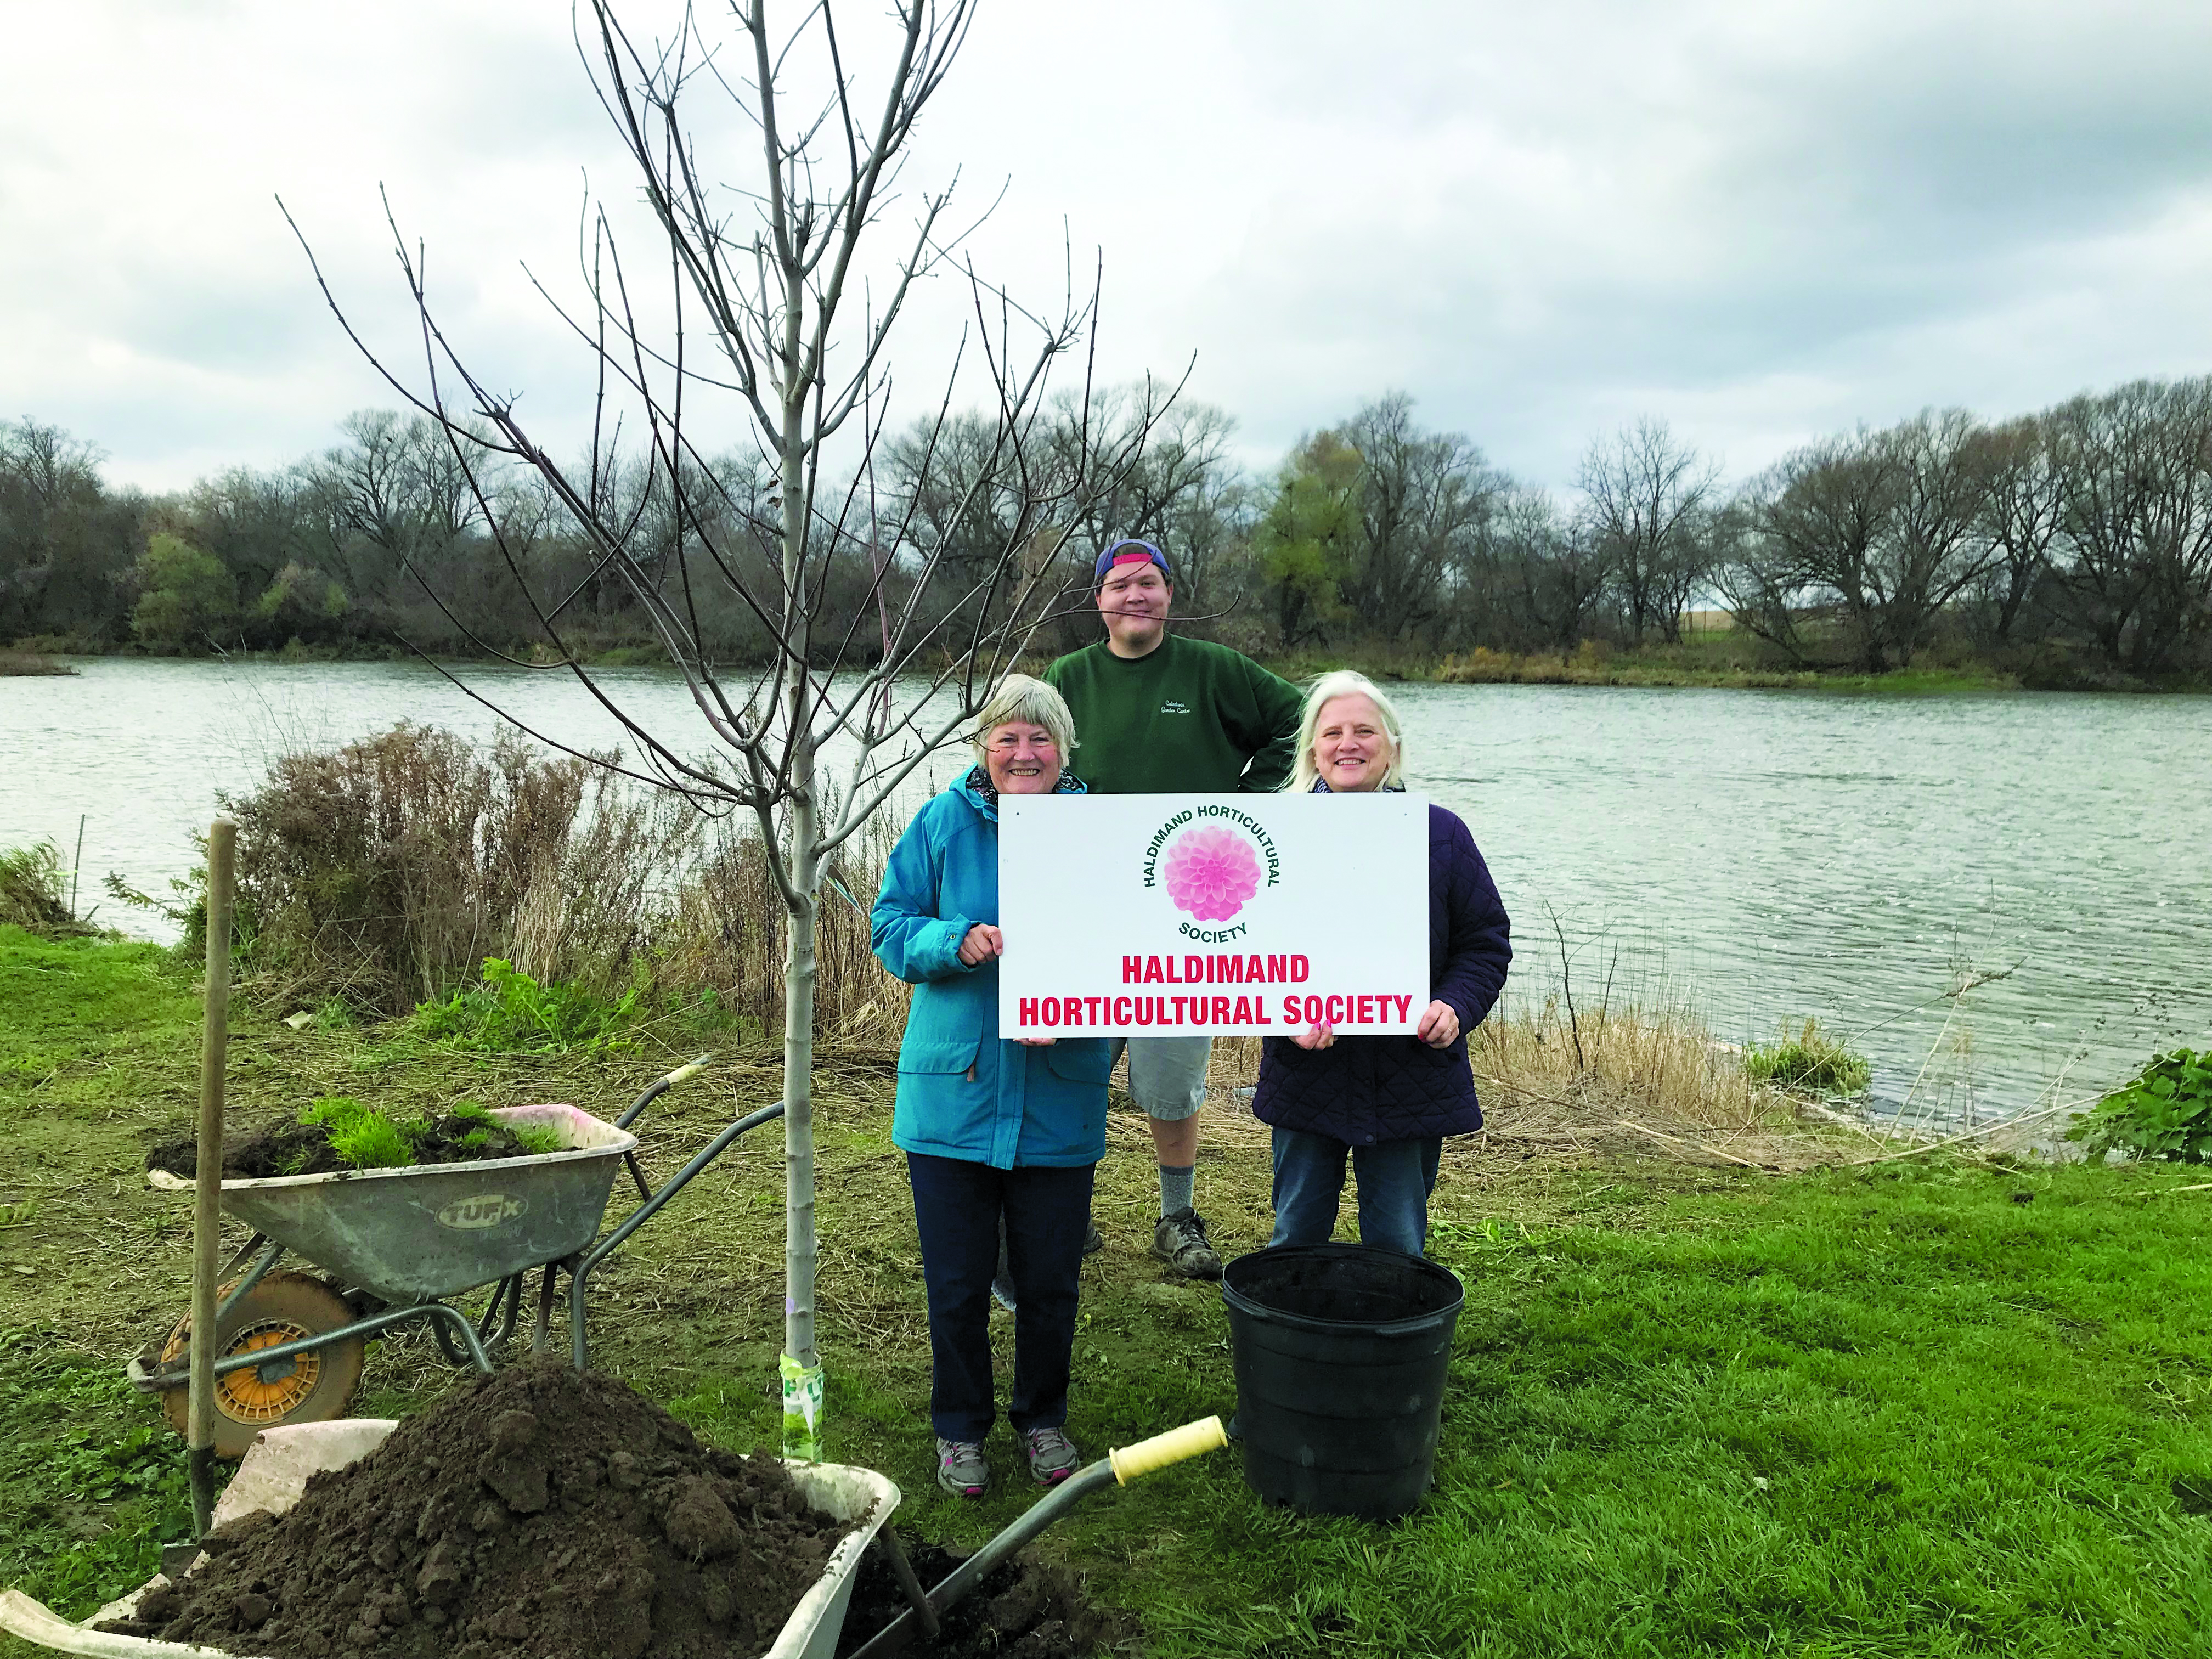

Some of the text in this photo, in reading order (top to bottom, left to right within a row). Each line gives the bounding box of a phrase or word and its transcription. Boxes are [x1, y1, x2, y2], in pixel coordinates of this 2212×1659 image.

[1144, 805, 1280, 888] HALDIMAND HORTICULTURAL
[1178, 922, 1247, 943] SOCIETY
[1122, 955, 1309, 984] HALDIMAND
[1019, 995, 1413, 1026] HORTICULTURAL SOCIETY
[445, 1199, 521, 1223] TUFX
